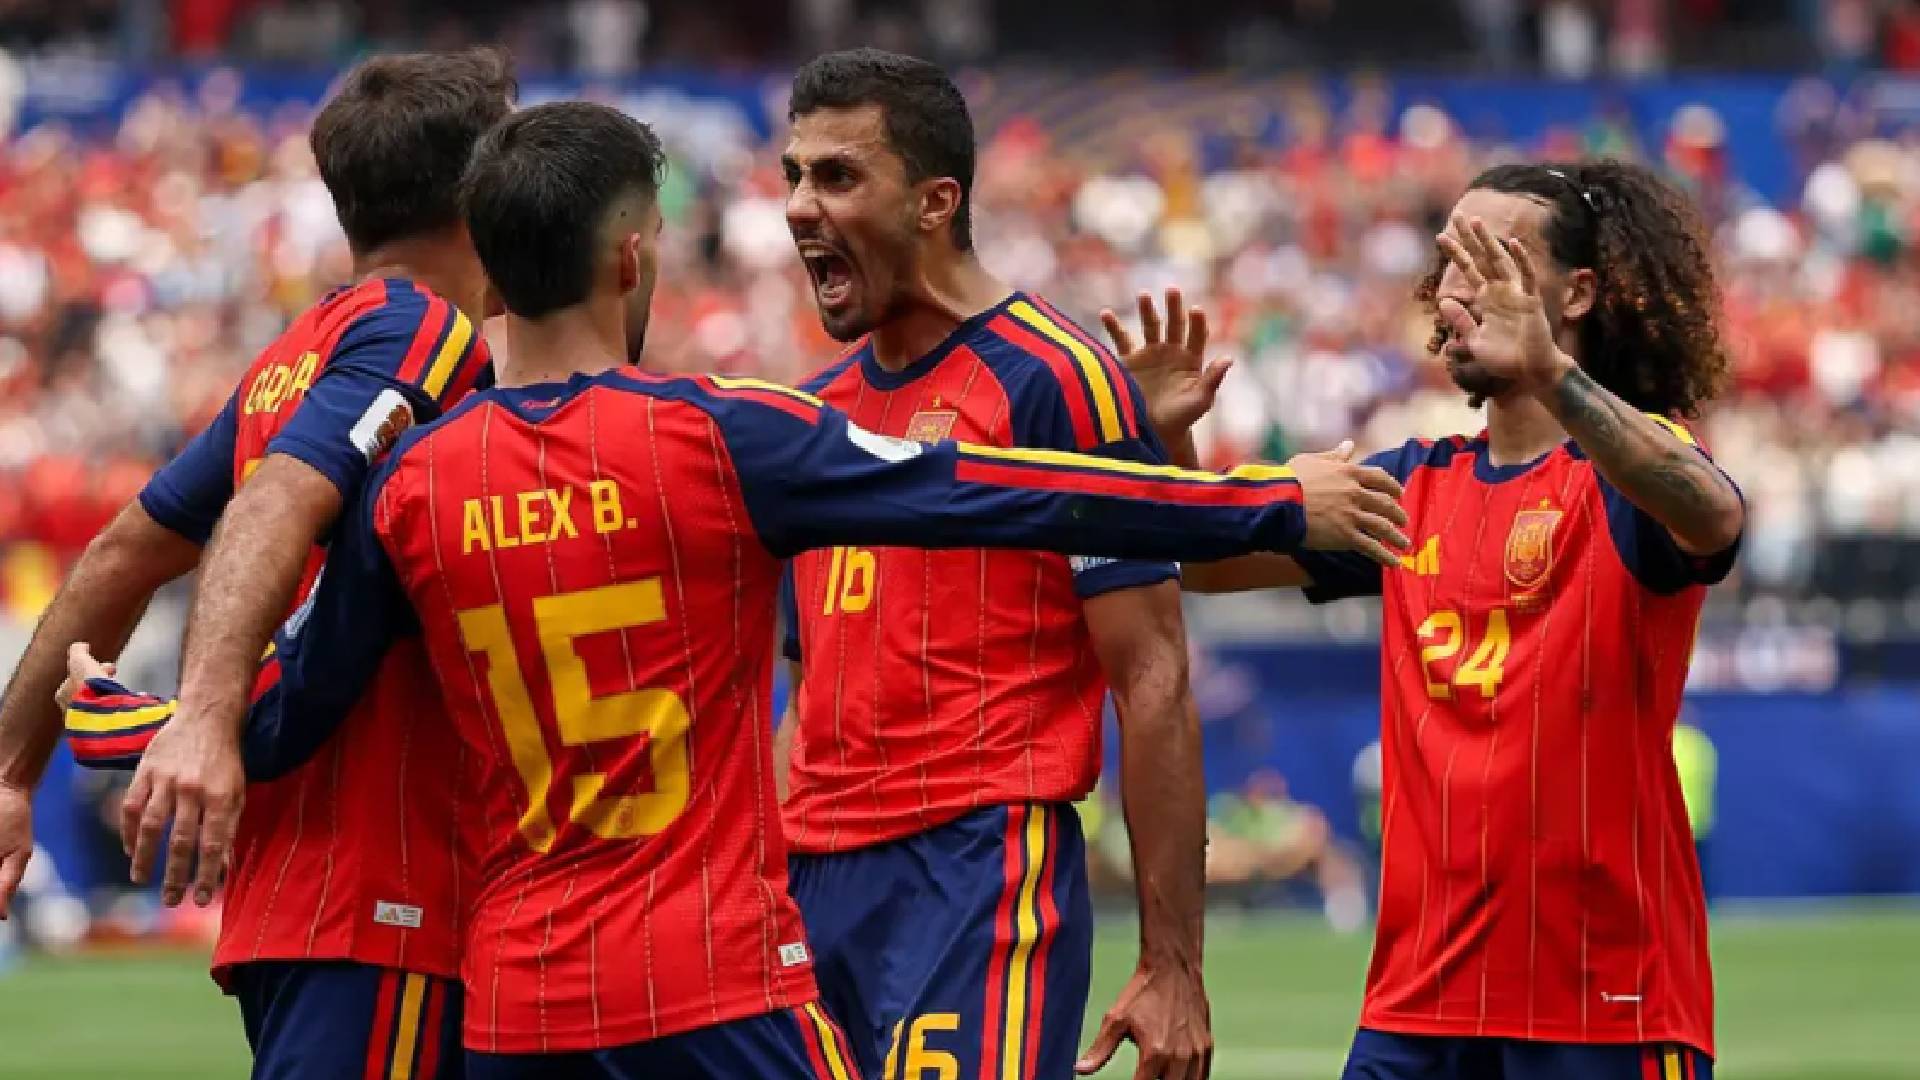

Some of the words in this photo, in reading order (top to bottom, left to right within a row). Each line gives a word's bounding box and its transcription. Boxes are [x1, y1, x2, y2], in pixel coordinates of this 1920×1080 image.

[463, 486, 578, 555] ALEX
[590, 480, 638, 533] B.
[824, 547, 876, 614] 16
[1417, 608, 1510, 698] 24
[456, 575, 690, 854] 15
[882, 1012, 960, 1080] 16
